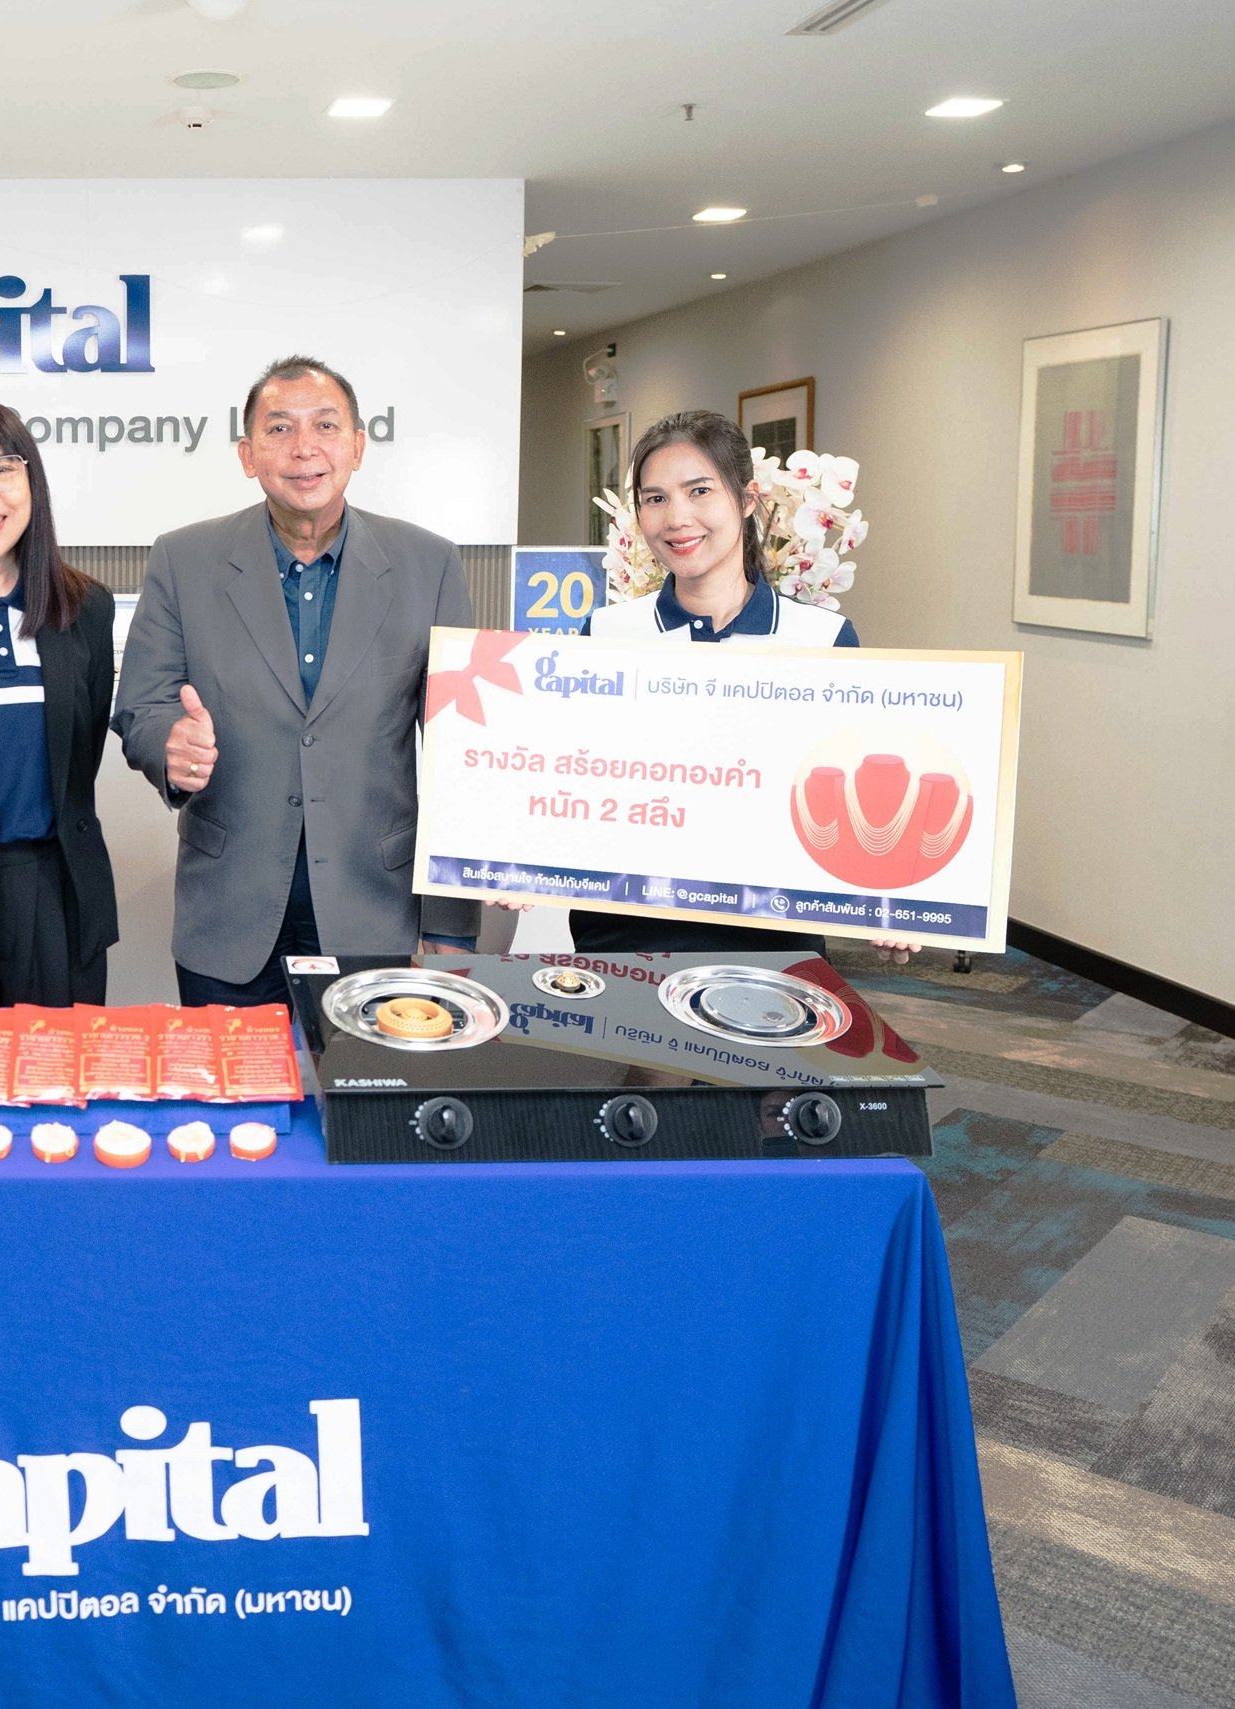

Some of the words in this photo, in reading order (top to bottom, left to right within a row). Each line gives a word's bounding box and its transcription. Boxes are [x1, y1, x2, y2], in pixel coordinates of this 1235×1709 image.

[7, 407, 207, 452] ompany
[526, 571, 594, 618] 20
[647, 677, 698, 696] บริษัท
[705, 679, 717, 696] จี
[722, 680, 815, 702] แคปปิตอล
[822, 682, 874, 704] จำกัด
[881, 688, 964, 712] (มหาชน)
[464, 745, 545, 773] รางวัล
[554, 749, 762, 789] สร้อยคอทองคำ
[528, 790, 590, 820] หนัก
[599, 798, 619, 822] 2
[627, 795, 686, 828] สลึง
[642, 886, 675, 899] LINE:
[677, 888, 738, 905] @gcapital
[795, 897, 866, 916] ลูกค้าสัมพันธ์
[875, 909, 952, 924] 02-651-9995
[334, 1079, 408, 1087] KASHIWA
[859, 1102, 887, 1111] X-3600
[2, 1590, 139, 1621] แคปปิตอล
[148, 1584, 227, 1615] จำกัด
[235, 1586, 352, 1619] (มหาชน)
